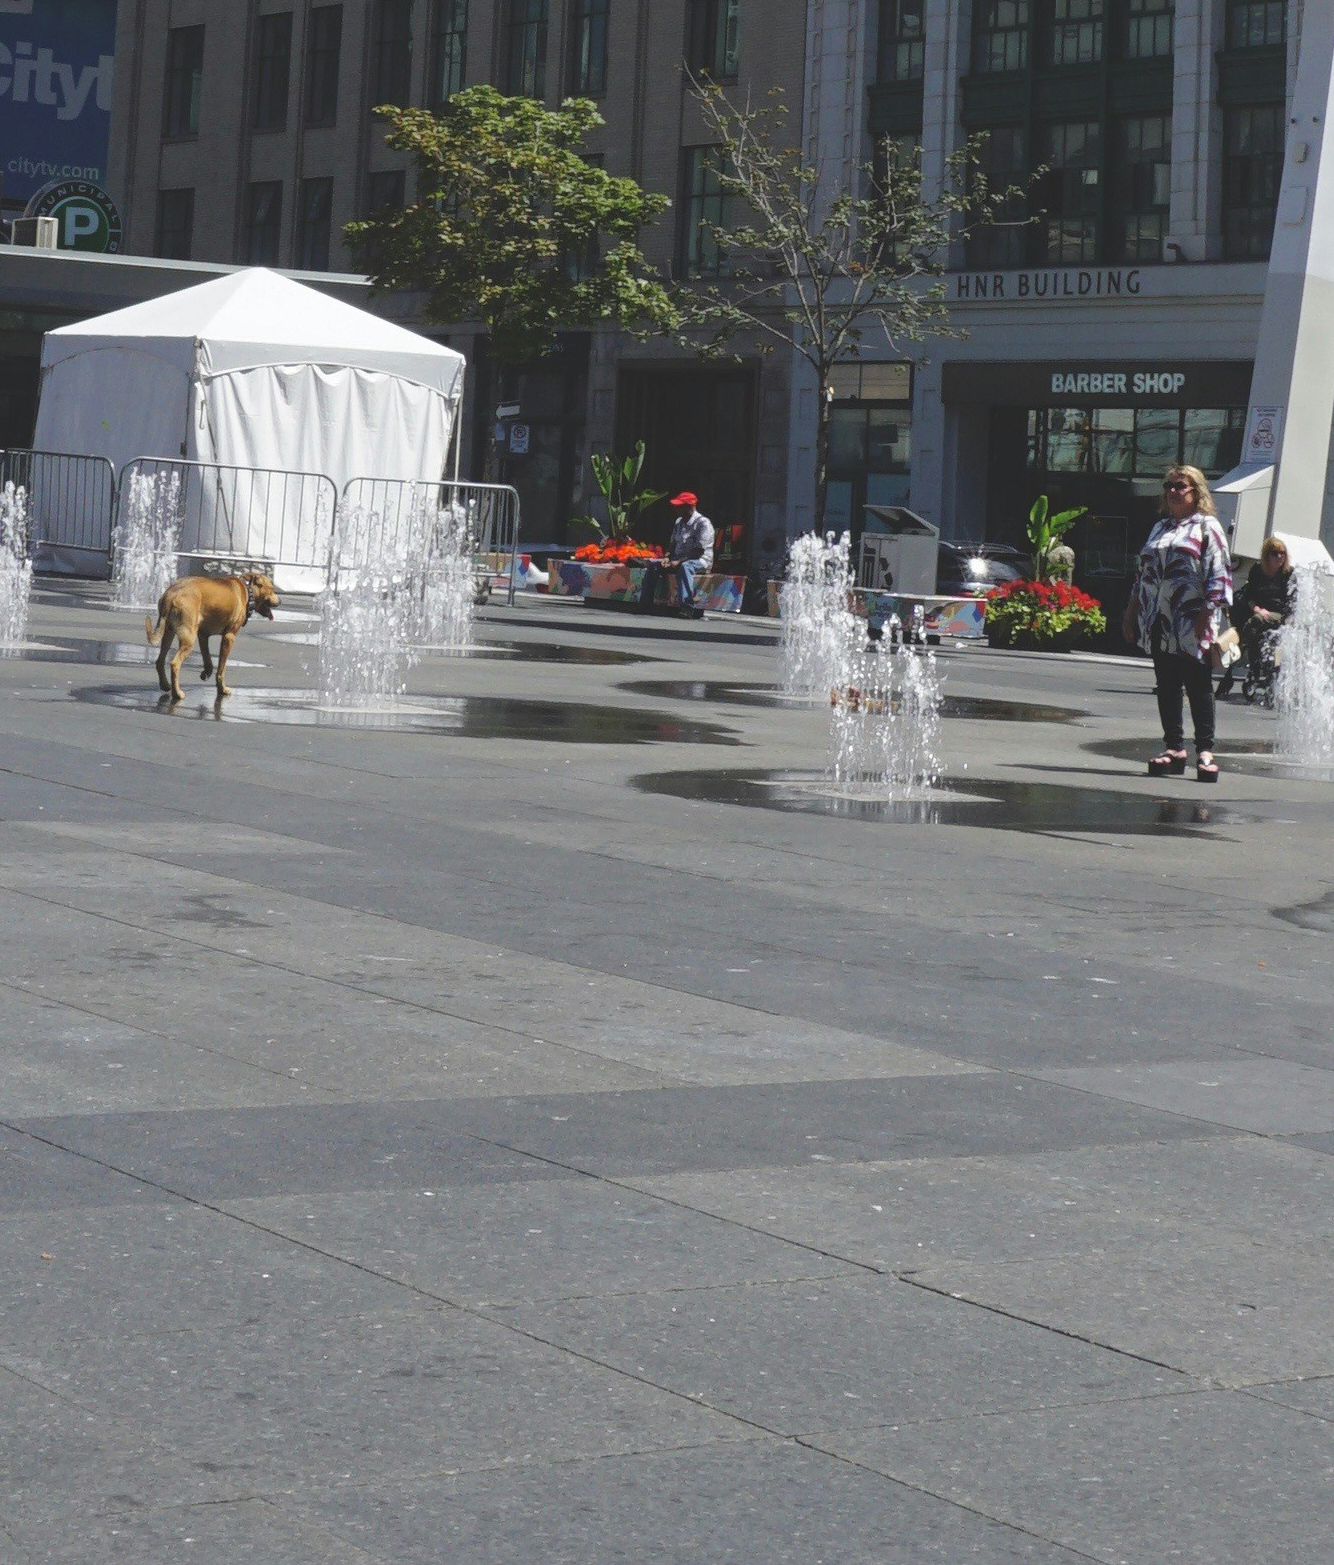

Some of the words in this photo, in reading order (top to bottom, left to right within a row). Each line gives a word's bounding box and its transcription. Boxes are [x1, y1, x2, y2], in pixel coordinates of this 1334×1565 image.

[8, 157, 99, 180] citytv.com
[38, 184, 119, 223] MUNICIPAL
[64, 206, 99, 246] P
[957, 274, 1005, 298] HNR
[1017, 270, 1140, 297] BUILDING
[1051, 373, 1127, 394] BARBER
[1132, 372, 1186, 394] SHOP
